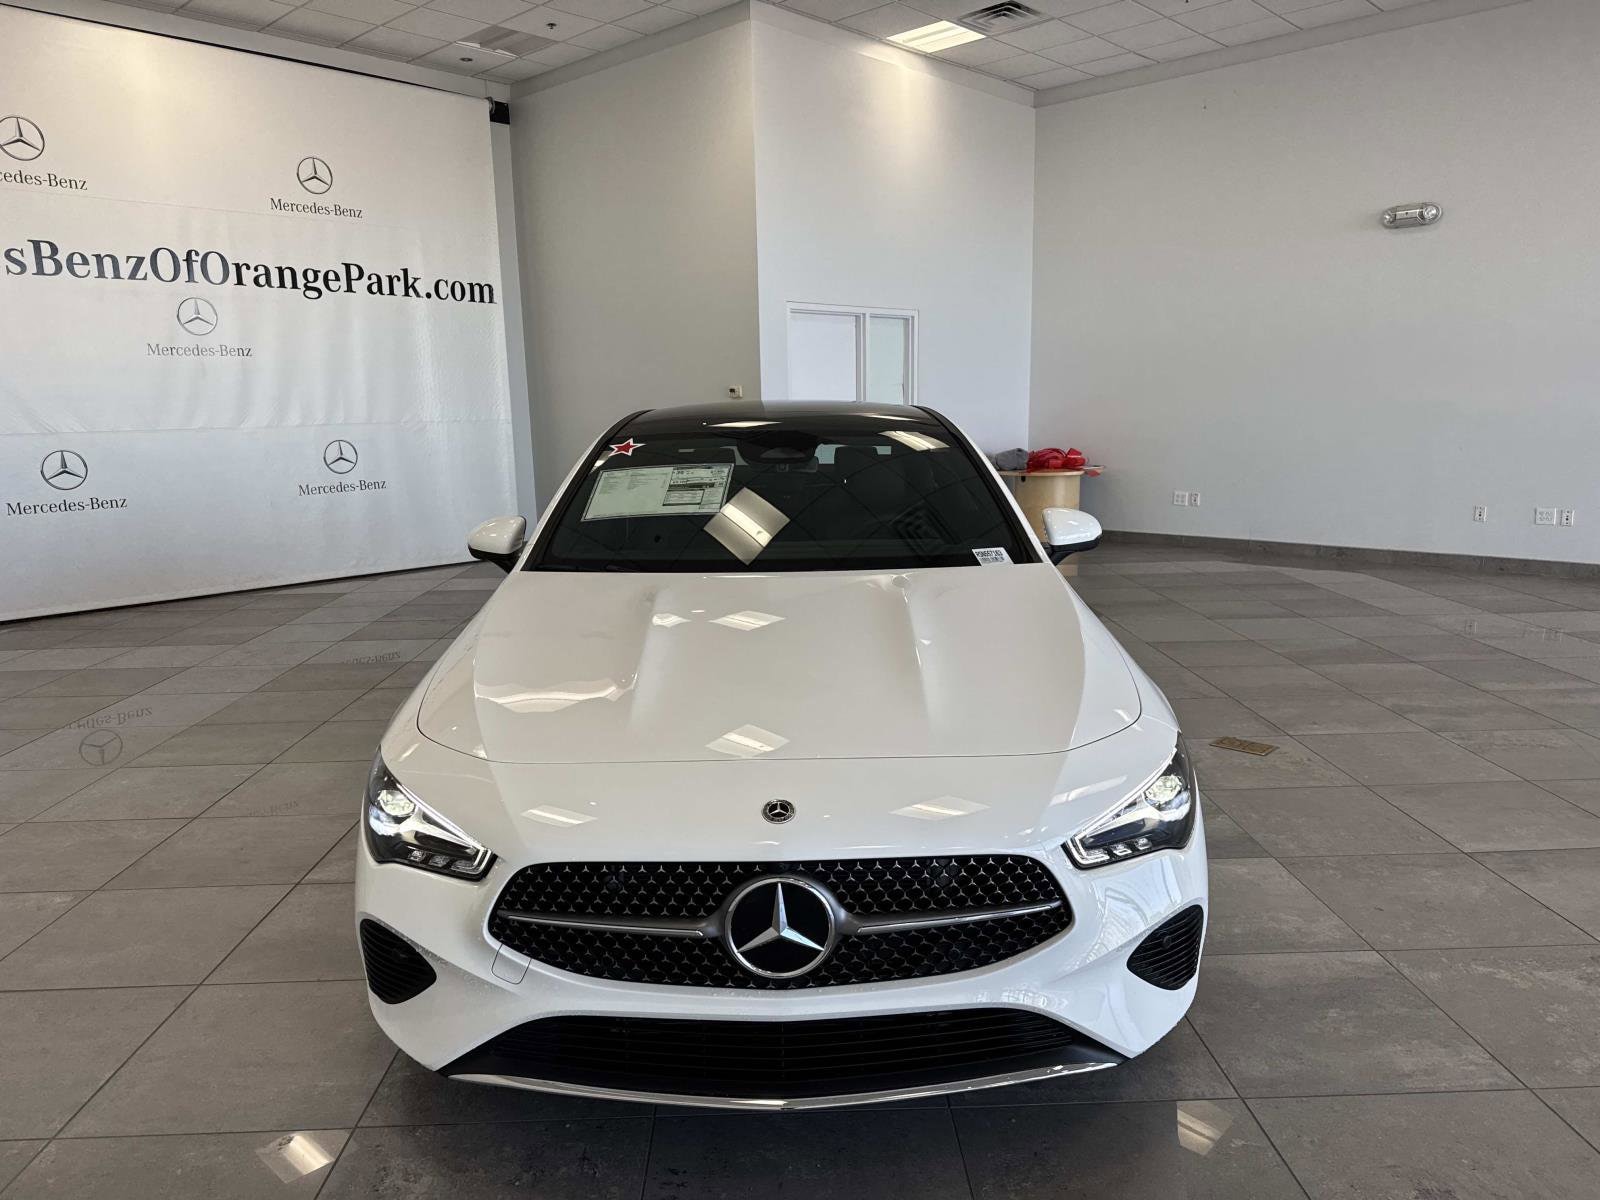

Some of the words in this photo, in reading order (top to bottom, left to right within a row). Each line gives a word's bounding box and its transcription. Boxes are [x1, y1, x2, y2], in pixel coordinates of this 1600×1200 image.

[270, 197, 363, 219] Mercedes-Benz
[4, 239, 498, 305] sBenzOfOrangePark.com
[147, 342, 253, 358] Mercedes-Benz
[298, 479, 387, 497] Mercedes-Benz
[6, 496, 128, 516] Mercedes-Benz
